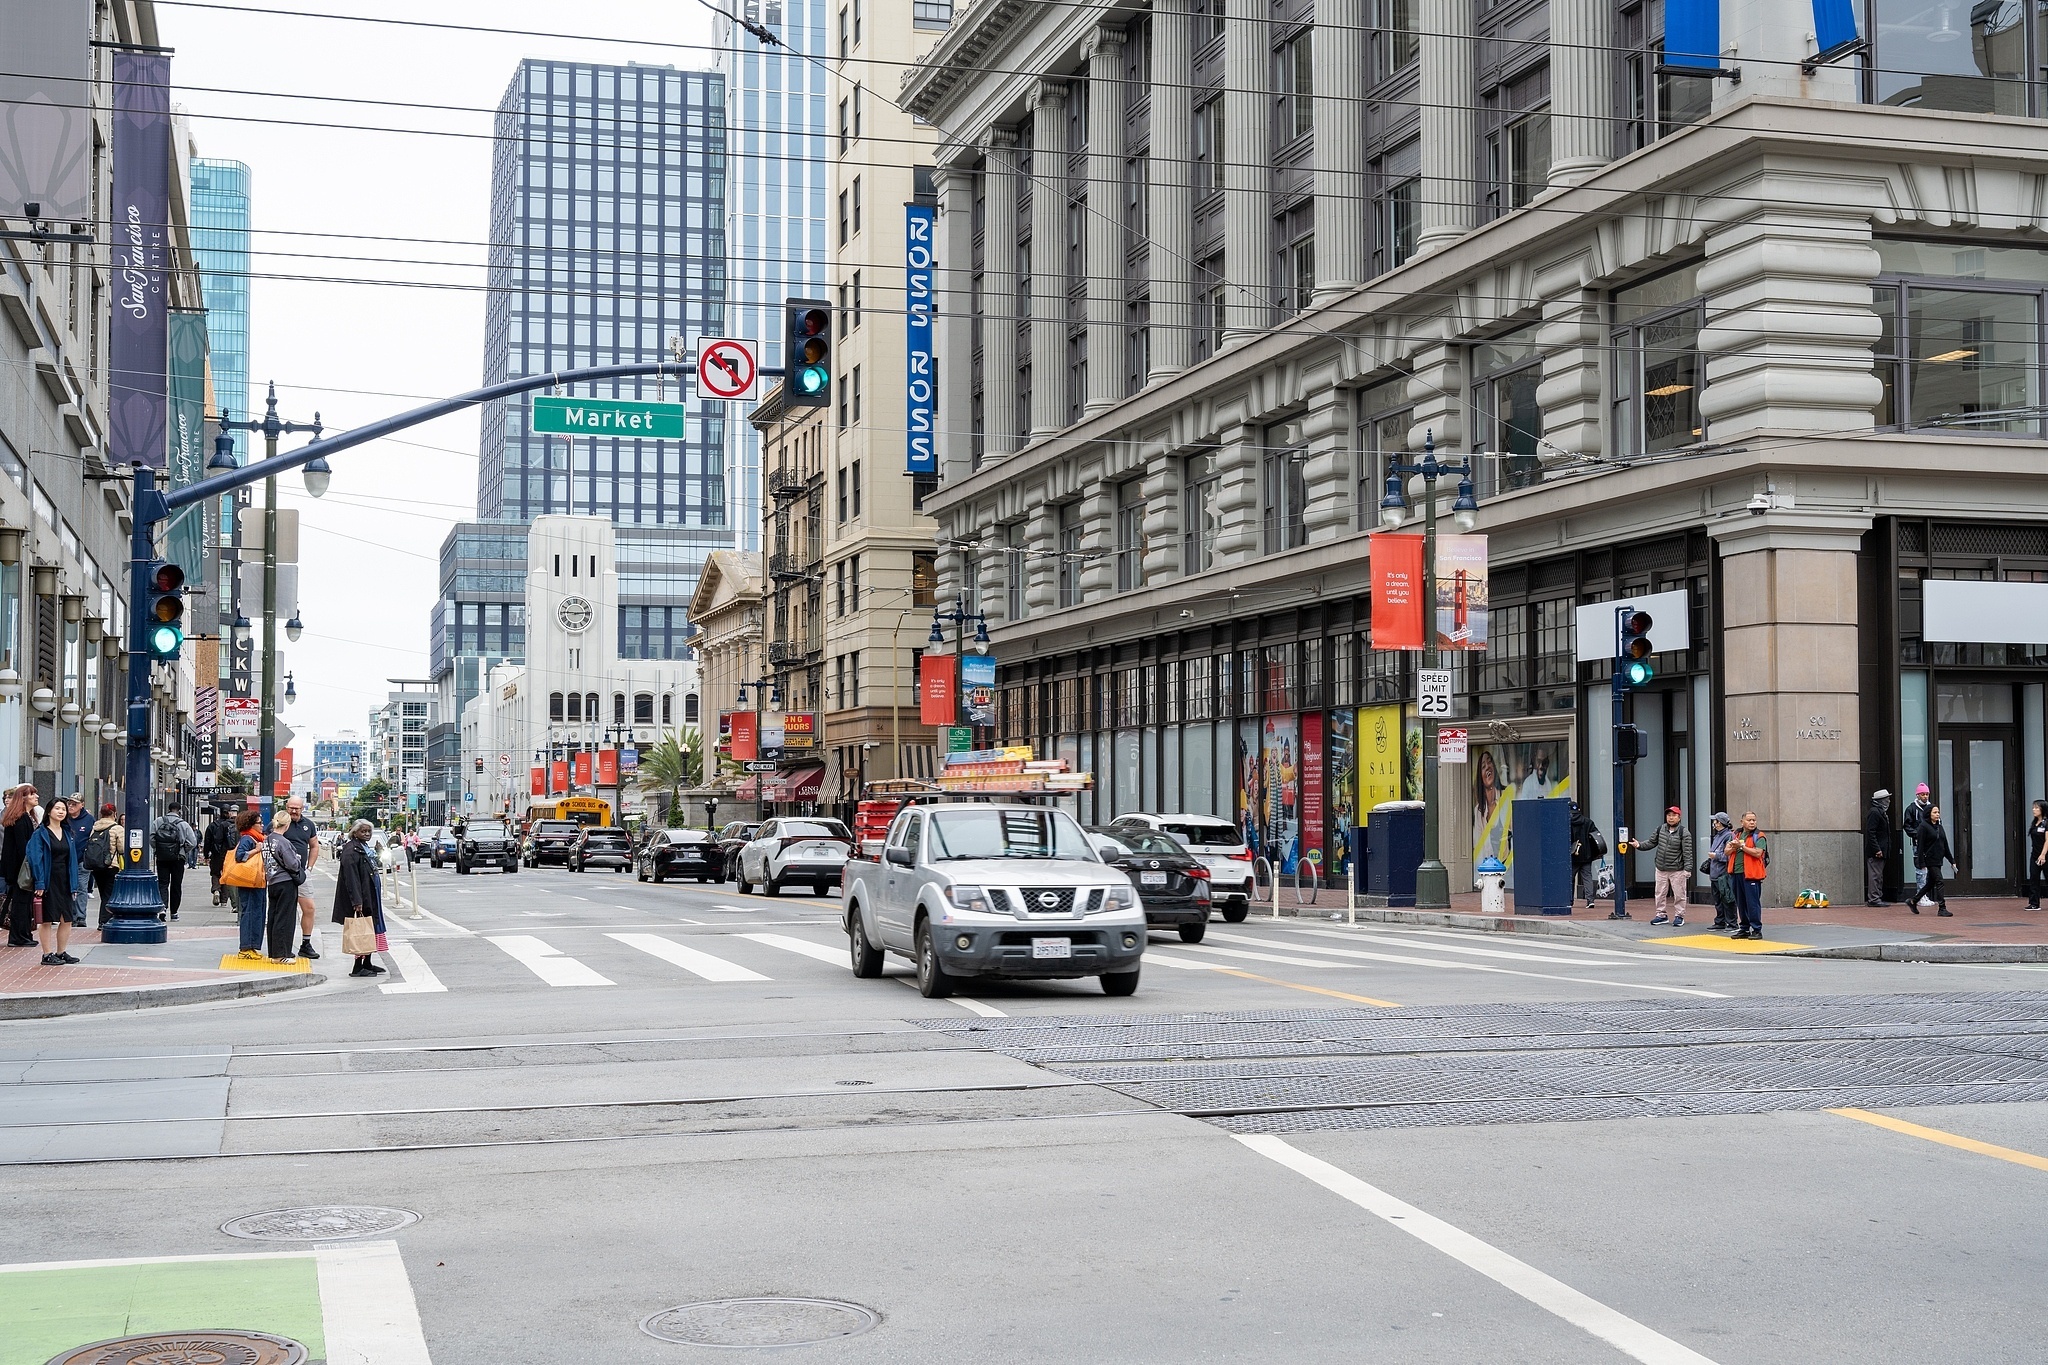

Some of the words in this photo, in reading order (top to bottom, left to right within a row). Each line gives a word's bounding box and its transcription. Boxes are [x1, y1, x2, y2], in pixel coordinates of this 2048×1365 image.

[152, 232, 160, 294] CENTRE
[908, 217, 930, 327] ROSS
[909, 351, 930, 462] ROSS
[566, 407, 653, 430] Market
[1396, 572, 1408, 580] only
[1421, 674, 1449, 683] SPEED
[1422, 694, 1448, 712] 25
[1810, 716, 1827, 726] 901
[1732, 730, 1762, 740] MARKET
[1796, 729, 1842, 740] MARKET
[202, 725, 212, 766] zetta
